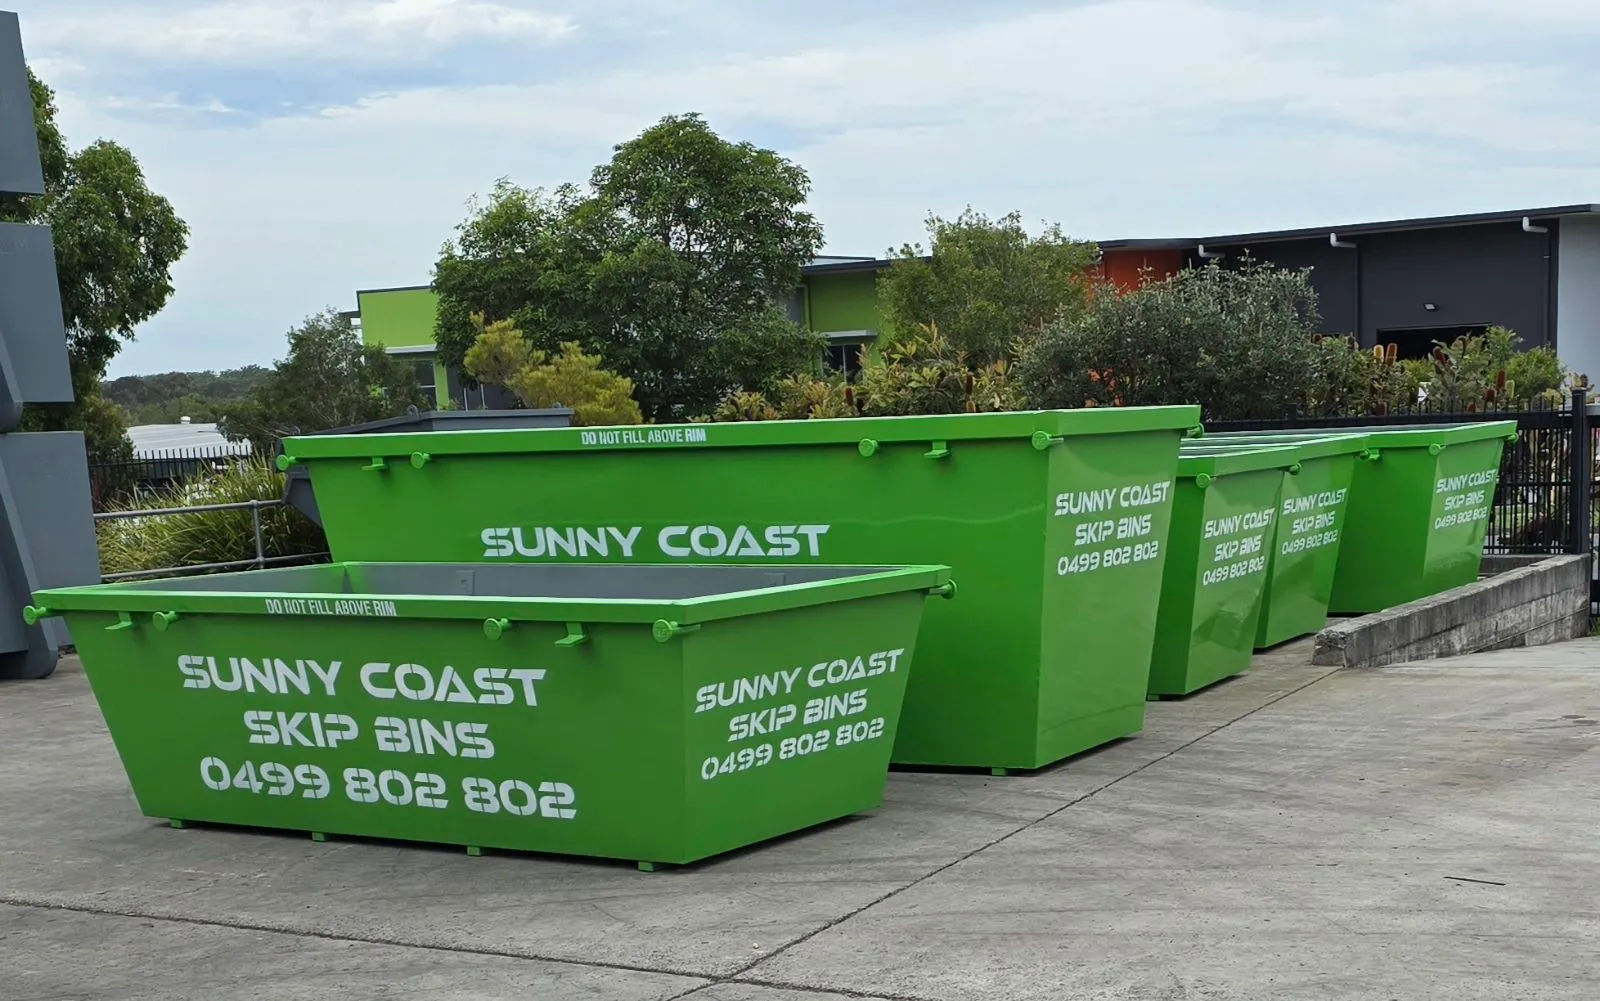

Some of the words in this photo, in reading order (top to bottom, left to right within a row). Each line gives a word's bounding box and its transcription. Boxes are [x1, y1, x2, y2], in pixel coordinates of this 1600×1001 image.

[581, 431, 597, 445] DO
[599, 430, 620, 445] NOT
[622, 430, 646, 444] FILL
[648, 428, 684, 443] ABOVE
[684, 428, 707, 442] RIM
[1436, 474, 1468, 493] SUNNY
[1468, 469, 1497, 487] COAST
[1055, 488, 1117, 516] SUNNY
[1120, 481, 1171, 508] COAST
[1282, 494, 1317, 516] SUNNY
[1317, 488, 1348, 508] COAST
[1444, 494, 1465, 511] SKIP
[1465, 490, 1485, 506] BINS
[1074, 520, 1114, 546] SKIP
[1116, 513, 1152, 540] BINS
[1204, 514, 1242, 539] SUNNY
[1243, 507, 1275, 530] COAST
[1292, 516, 1314, 534] SKIP
[1314, 511, 1336, 529] BINS
[481, 526, 641, 557] SUNNY
[658, 524, 830, 557] COAST
[1214, 541, 1239, 562] SKIP
[1240, 534, 1262, 556] BINS
[1057, 551, 1101, 576] 0499
[1103, 546, 1132, 568] 802
[1133, 540, 1159, 562] 802
[1203, 566, 1229, 586] 0499
[1229, 560, 1248, 578] 802
[1248, 555, 1265, 574] 802
[265, 598, 281, 615] DO
[283, 599, 306, 614] NOT
[307, 599, 334, 615] FILL
[335, 600, 373, 616] ABOVE
[372, 600, 397, 617] RIM
[178, 655, 342, 697] SUNNY
[360, 662, 546, 707] COAST
[695, 668, 802, 714] SUNNY
[807, 648, 905, 689] COAST
[727, 704, 797, 743] SKIP
[802, 687, 868, 726] BINS
[243, 710, 359, 749] SKIP
[374, 716, 495, 760] BINS
[700, 743, 774, 781] 0499
[779, 728, 831, 761] 802
[836, 716, 885, 747] 802
[200, 756, 331, 800] 0499
[343, 767, 449, 809] 802
[462, 777, 578, 820] 802
